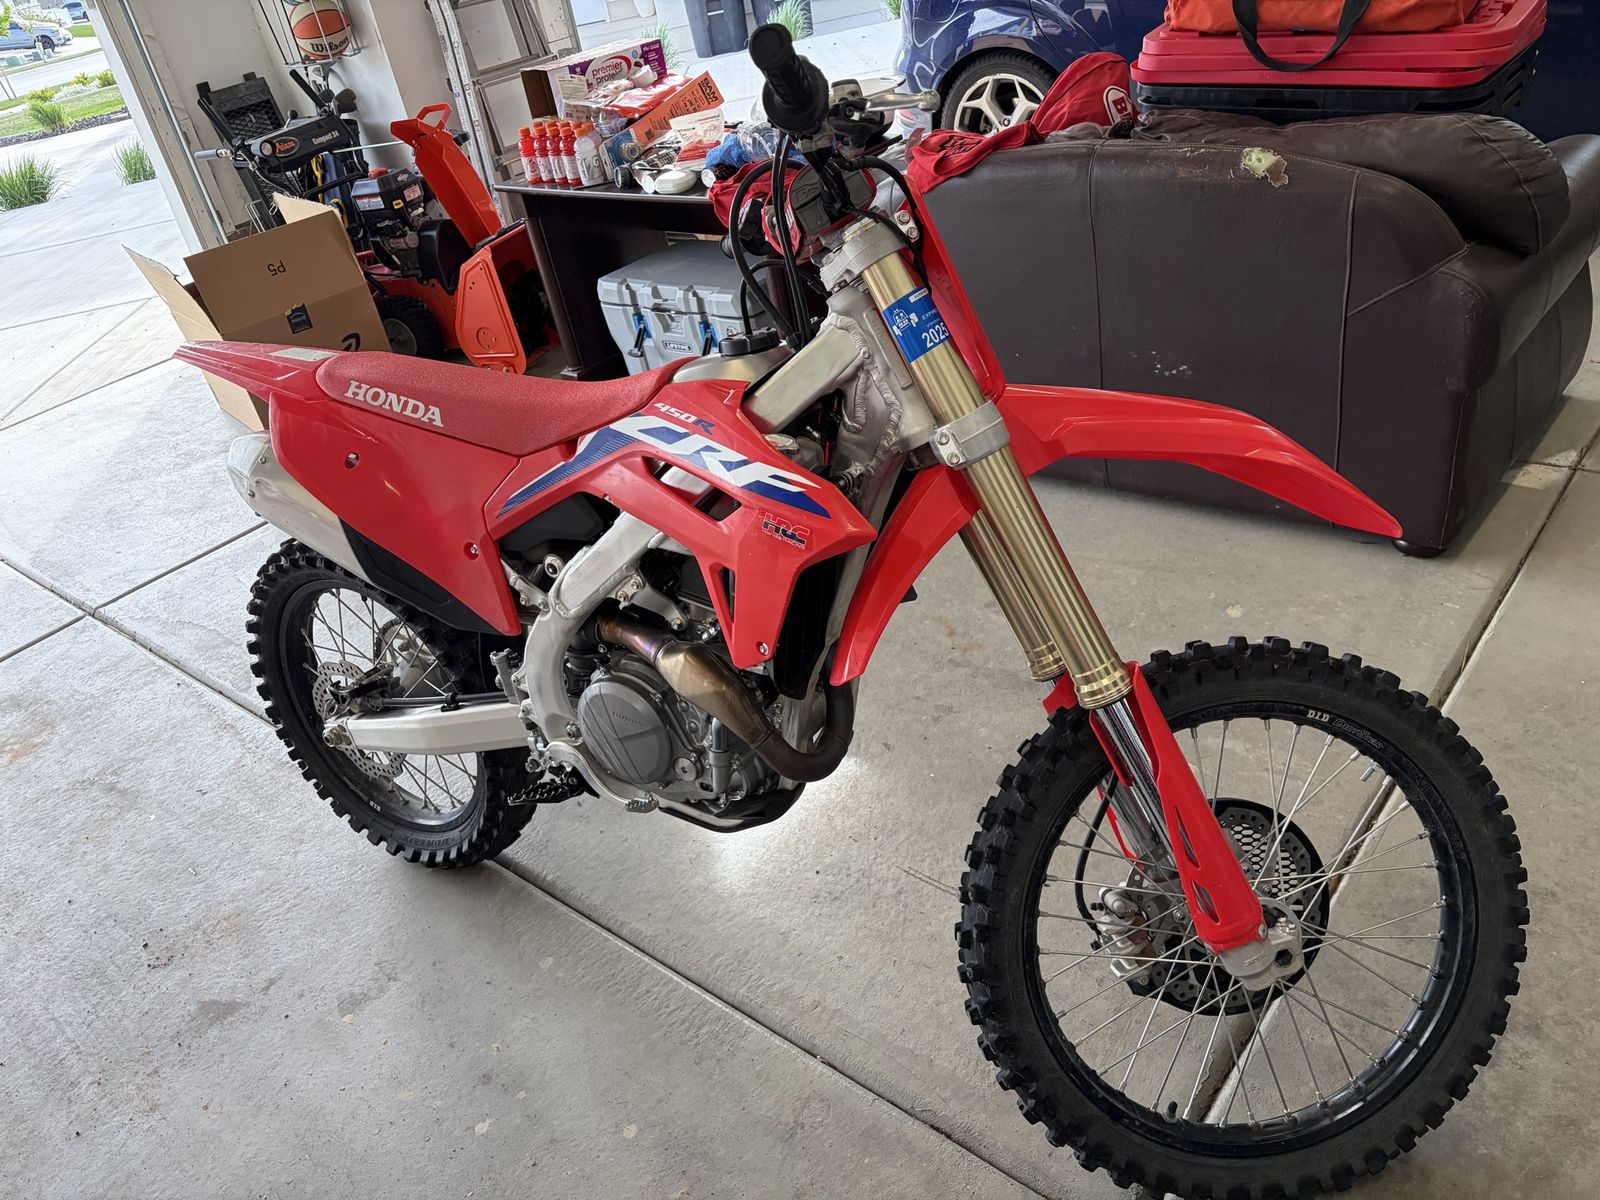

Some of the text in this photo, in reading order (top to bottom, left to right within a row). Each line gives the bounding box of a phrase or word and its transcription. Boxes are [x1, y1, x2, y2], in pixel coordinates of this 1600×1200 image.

[309, 36, 349, 53] Wilson
[592, 61, 623, 78] premier
[595, 69, 622, 86] prote
[312, 132, 332, 145] Compact
[267, 260, 287, 276] P5
[921, 322, 949, 348] 2025
[344, 380, 444, 427] HONDA
[653, 402, 716, 435] 450R
[609, 415, 822, 493] CRF
[762, 512, 810, 546] HRC
